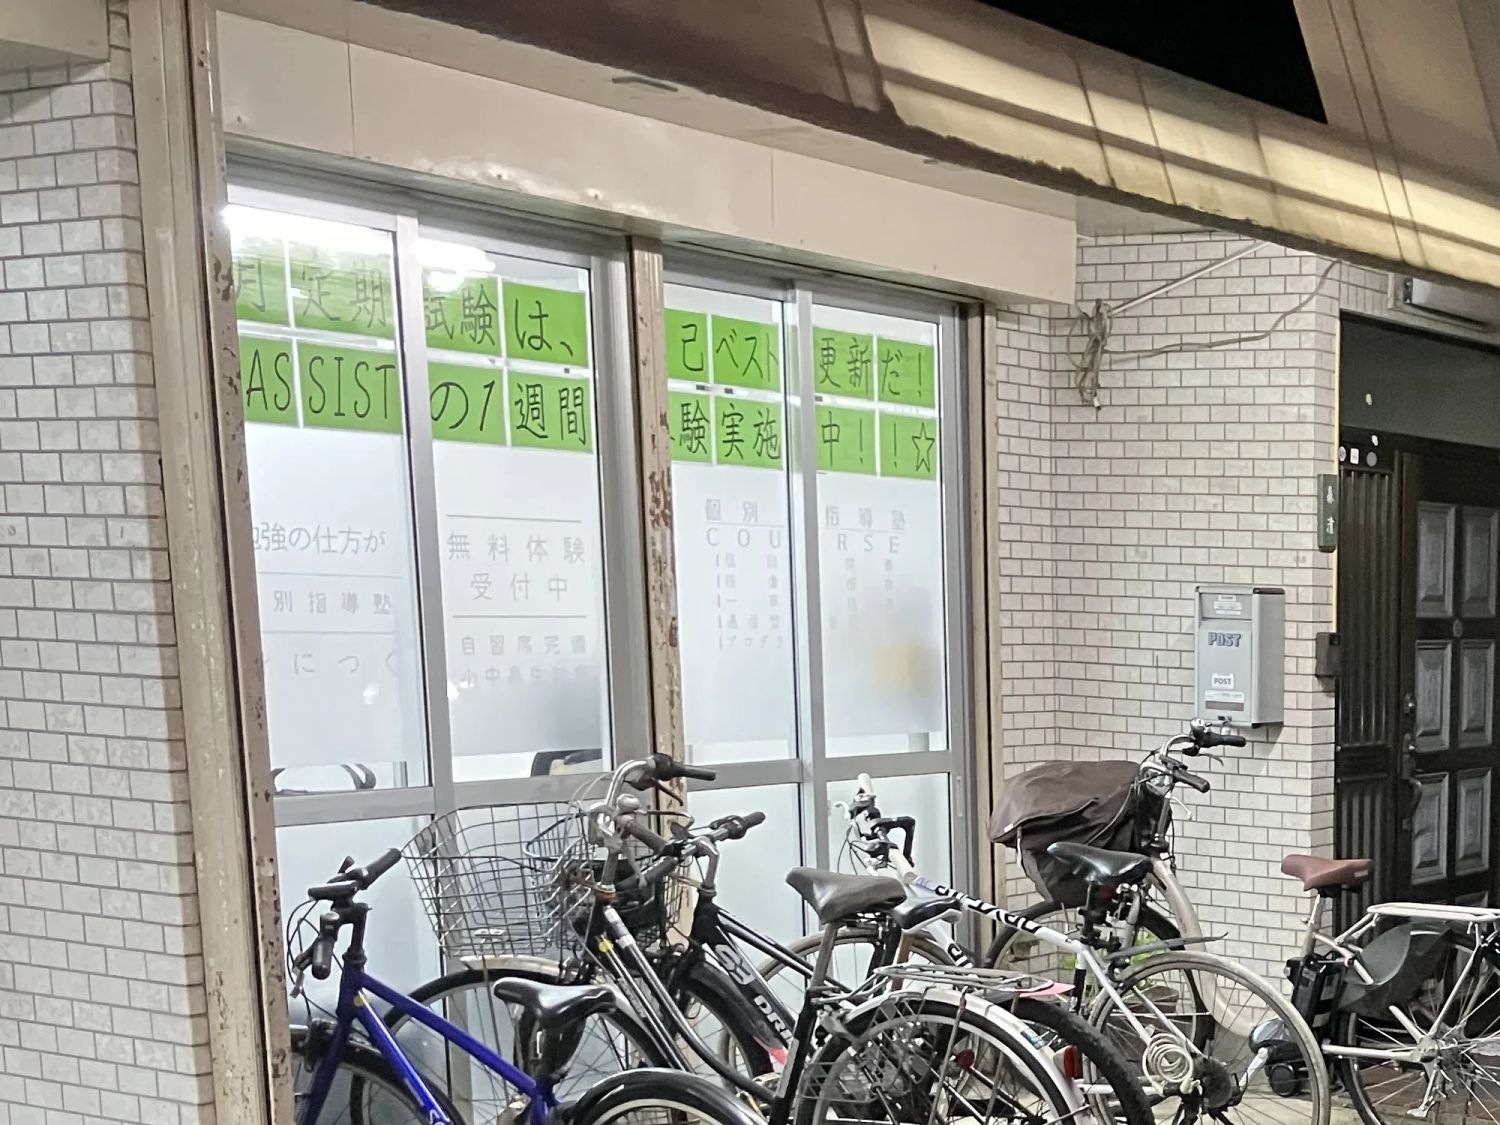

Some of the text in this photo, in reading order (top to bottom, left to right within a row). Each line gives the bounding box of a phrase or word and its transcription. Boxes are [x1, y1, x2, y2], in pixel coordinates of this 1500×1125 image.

[447, 532, 585, 563] 無料体験
[471, 572, 568, 602] 受付中
[1207, 631, 1242, 648] POST
[265, 652, 399, 678] につく
[1213, 677, 1232, 686] POST
